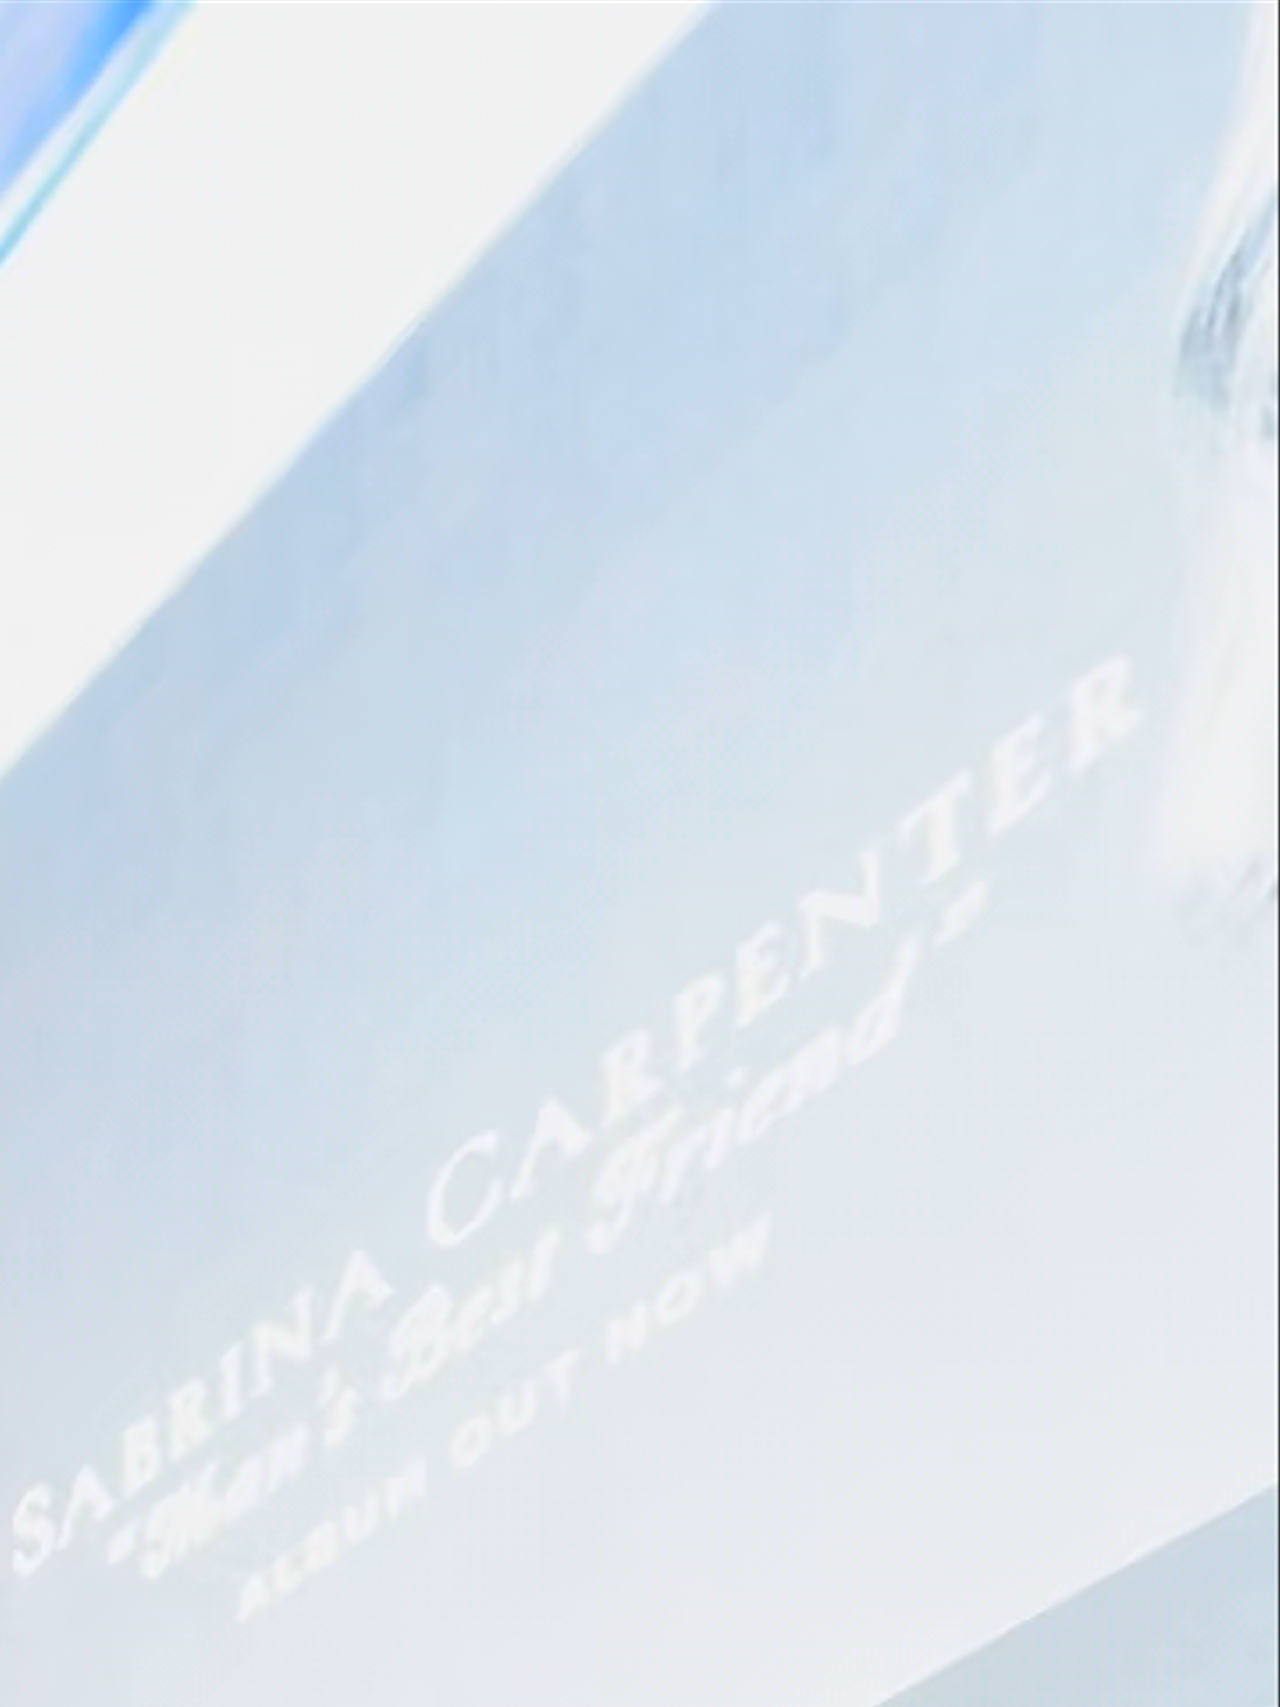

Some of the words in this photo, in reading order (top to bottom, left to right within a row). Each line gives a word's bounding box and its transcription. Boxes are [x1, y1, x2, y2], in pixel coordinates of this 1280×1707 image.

[12, 1248, 394, 1578] SABRINA
[425, 652, 1144, 1252] CARPENTER
[380, 1226, 560, 1402] Best
[236, 1448, 428, 1624] ALBUM
[450, 1348, 580, 1478] OUT
[604, 1210, 774, 1366] NOW
